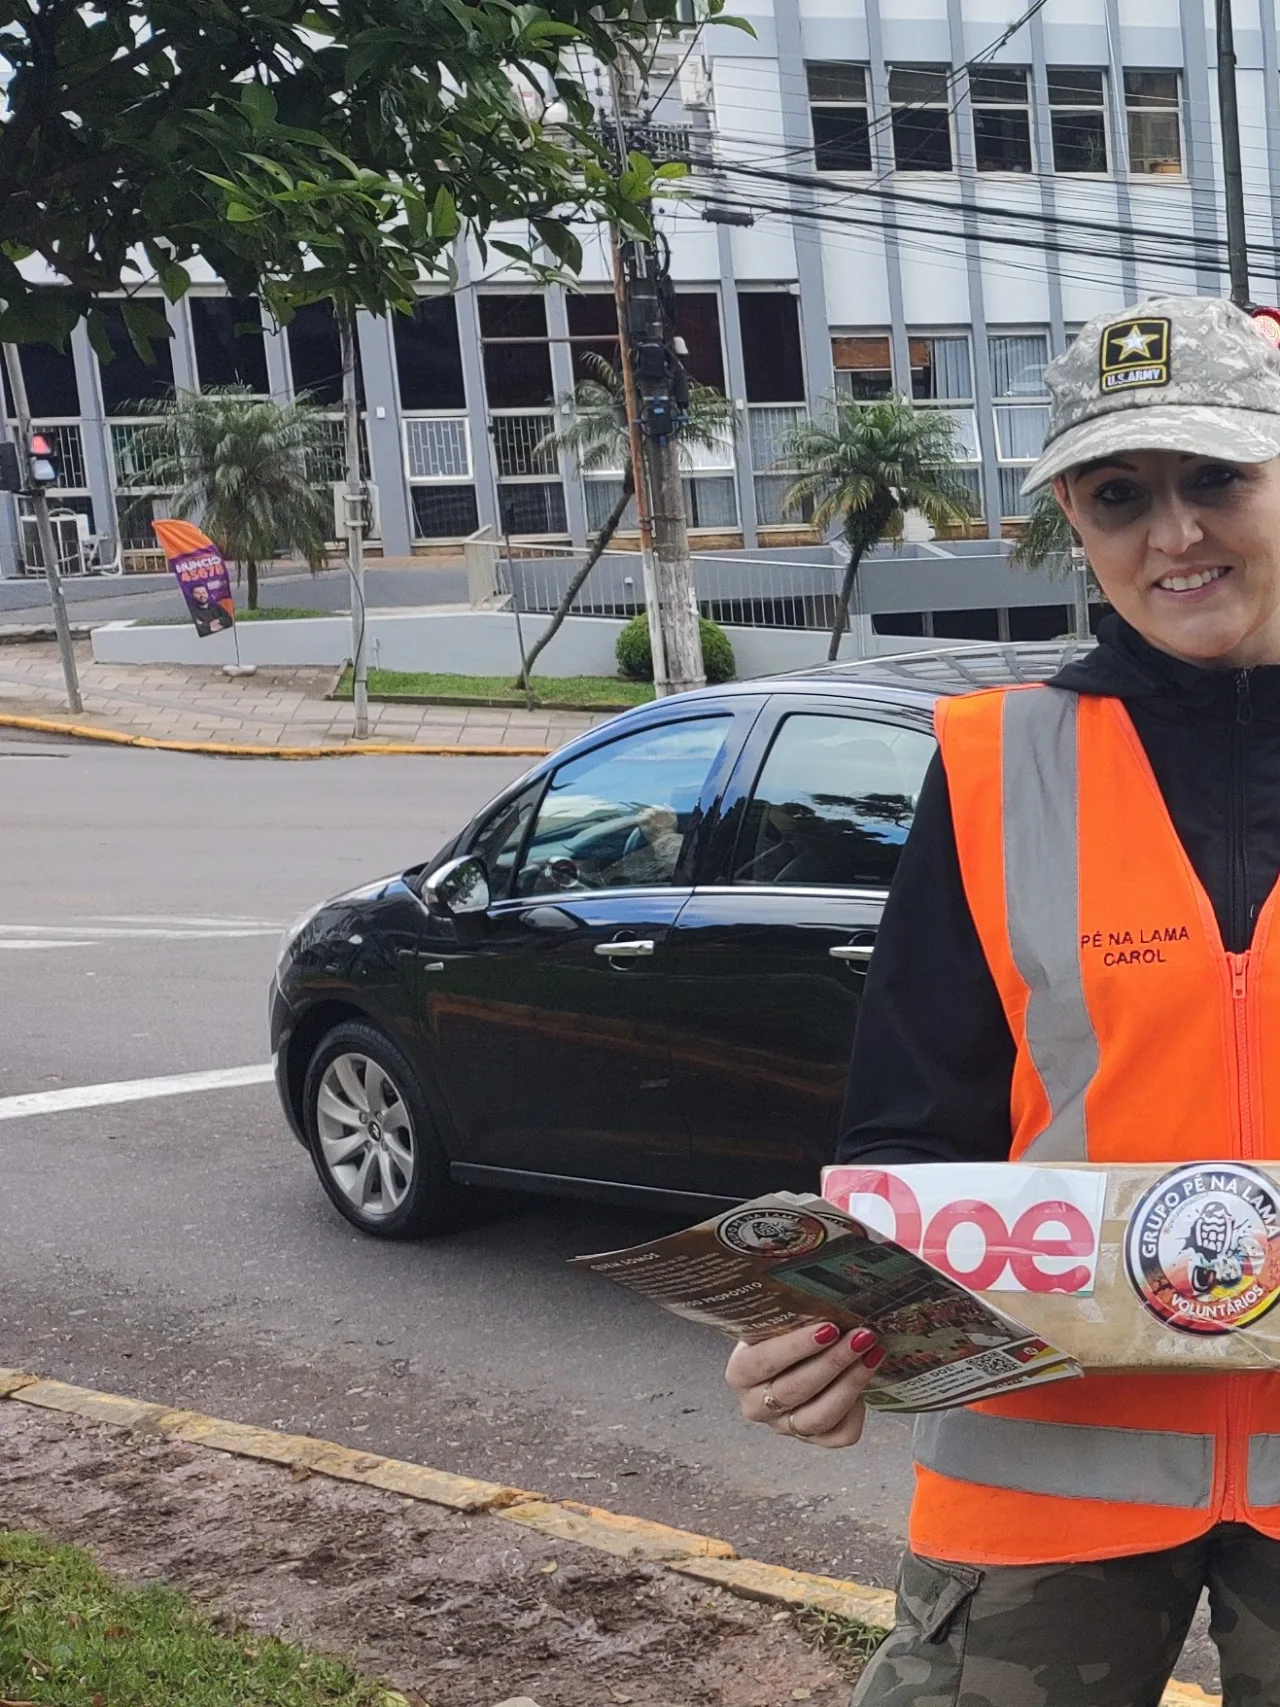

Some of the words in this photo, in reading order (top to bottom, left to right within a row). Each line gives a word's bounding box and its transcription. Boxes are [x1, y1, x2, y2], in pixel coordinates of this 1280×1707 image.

[1080, 930, 1103, 949] PÉ
[1108, 931, 1134, 946] NA
[1140, 926, 1190, 944] LAMA
[1103, 949, 1167, 967] CAROL
[824, 1169, 1095, 1293] Doe
[1142, 1192, 1181, 1259] GRUPO
[1182, 1173, 1207, 1197] PÉ
[1210, 1175, 1238, 1194] NA
[1170, 1284, 1265, 1318] VOLUNTÁRIOS
